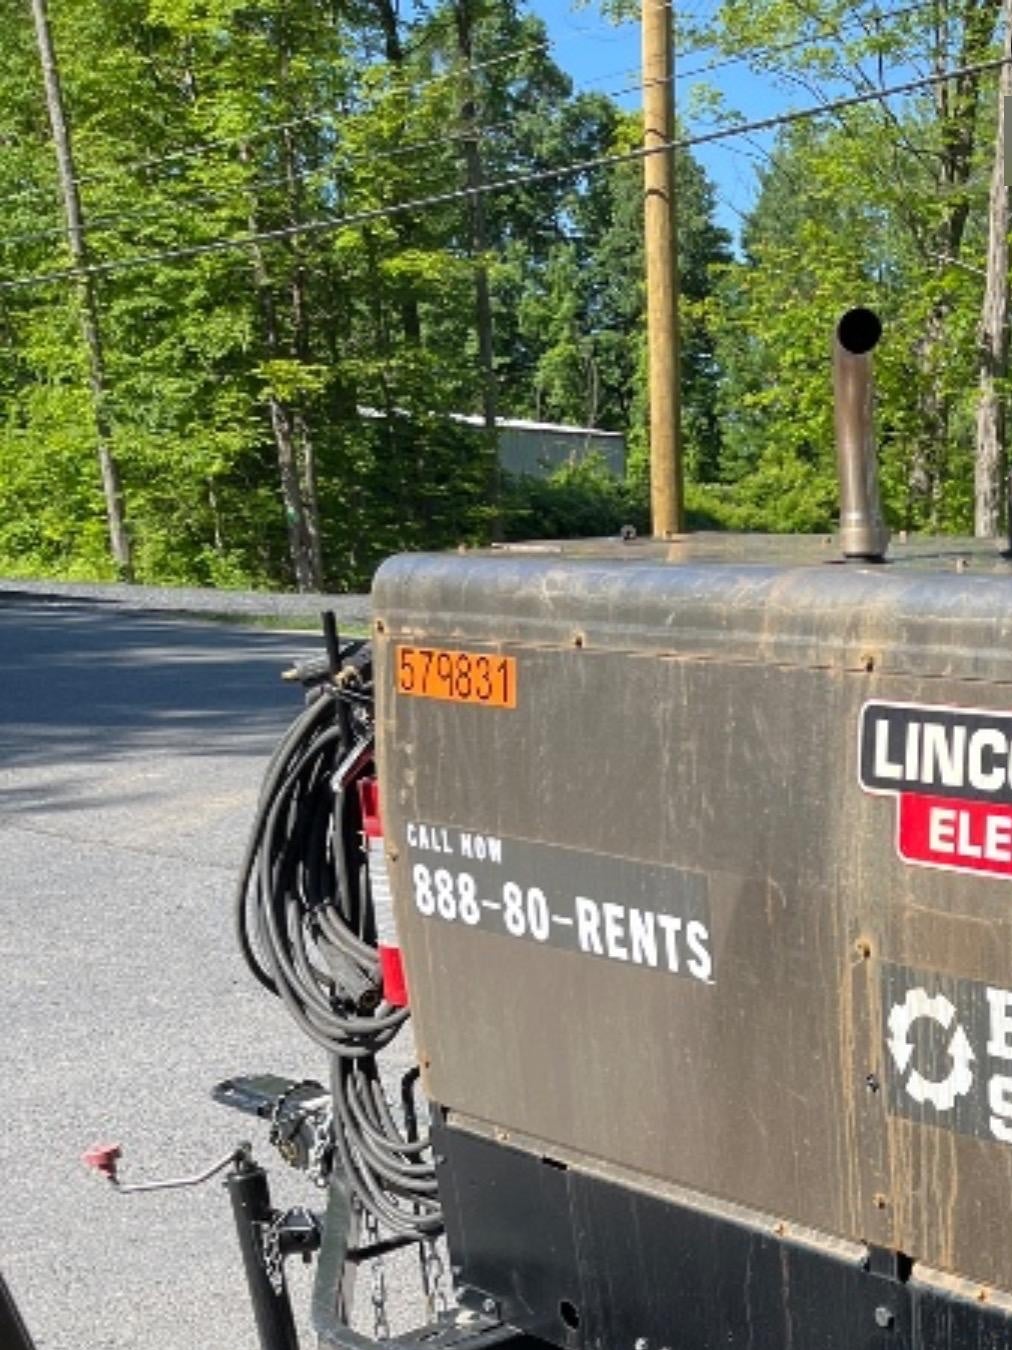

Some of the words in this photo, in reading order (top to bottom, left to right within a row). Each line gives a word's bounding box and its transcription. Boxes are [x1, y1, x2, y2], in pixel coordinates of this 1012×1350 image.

[400, 647, 510, 703] 579831
[407, 823, 453, 854] CALL
[461, 833, 503, 864] NOW
[413, 863, 713, 980] 888-80-RENTS
